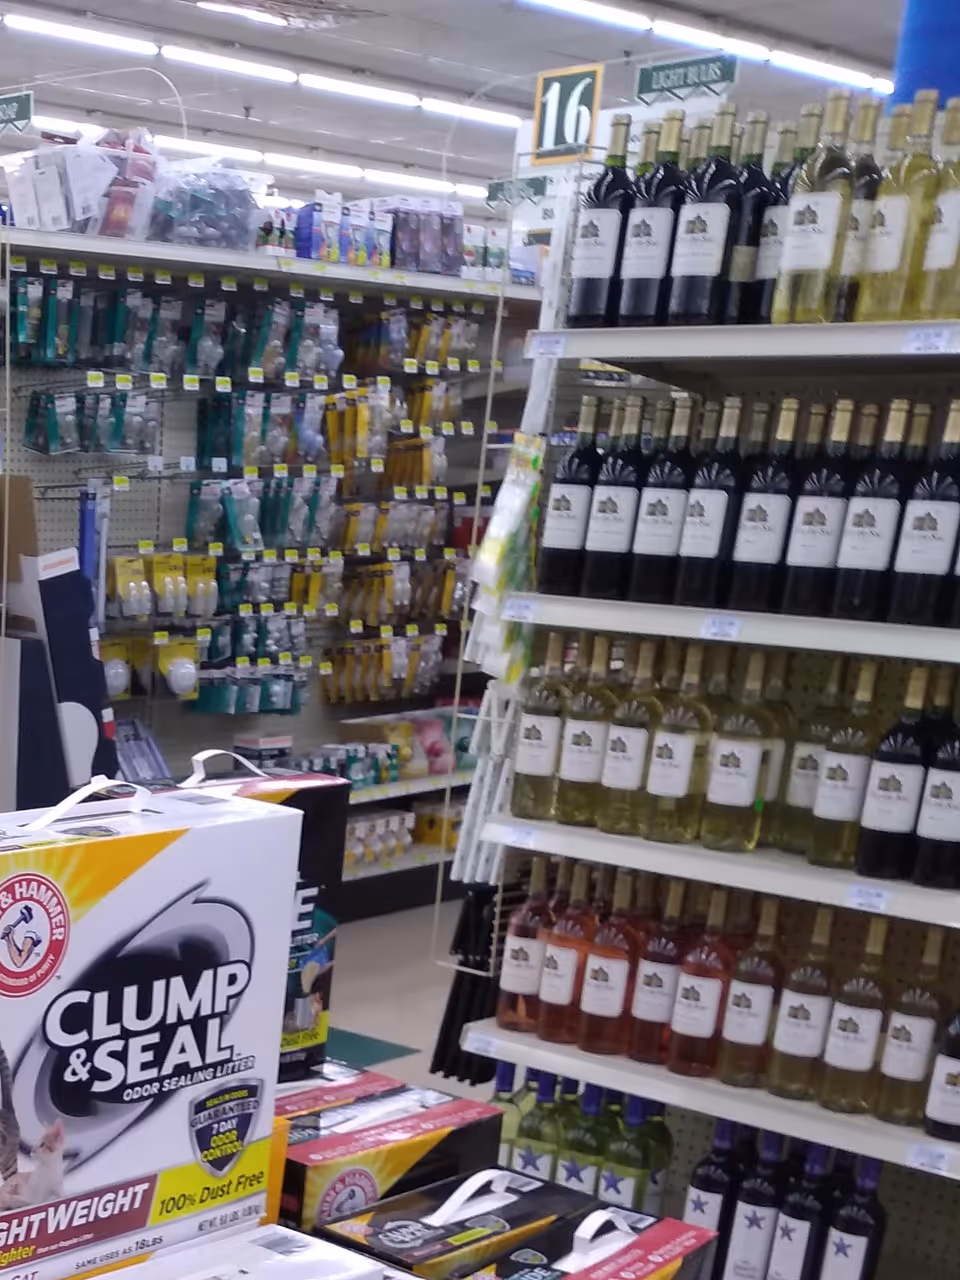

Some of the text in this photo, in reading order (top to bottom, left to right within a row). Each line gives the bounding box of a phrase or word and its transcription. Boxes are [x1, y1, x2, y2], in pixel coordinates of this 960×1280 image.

[541, 77, 593, 152] 16
[0, 891, 14, 909] &
[14, 881, 65, 940] HAMMER
[45, 963, 250, 1048] CLUMP
[123, 1055, 256, 1101] ODOR SEALING LITTER
[191, 1099, 260, 1128] GUARANTEED
[212, 1117, 238, 1133] 7 DAY
[210, 1130, 238, 1147] ODOR
[159, 1170, 264, 1217] 100% Dust Free
[75, 1256, 98, 1270] SAME
[100, 1250, 120, 1263] USES
[123, 1246, 133, 1255] AS
